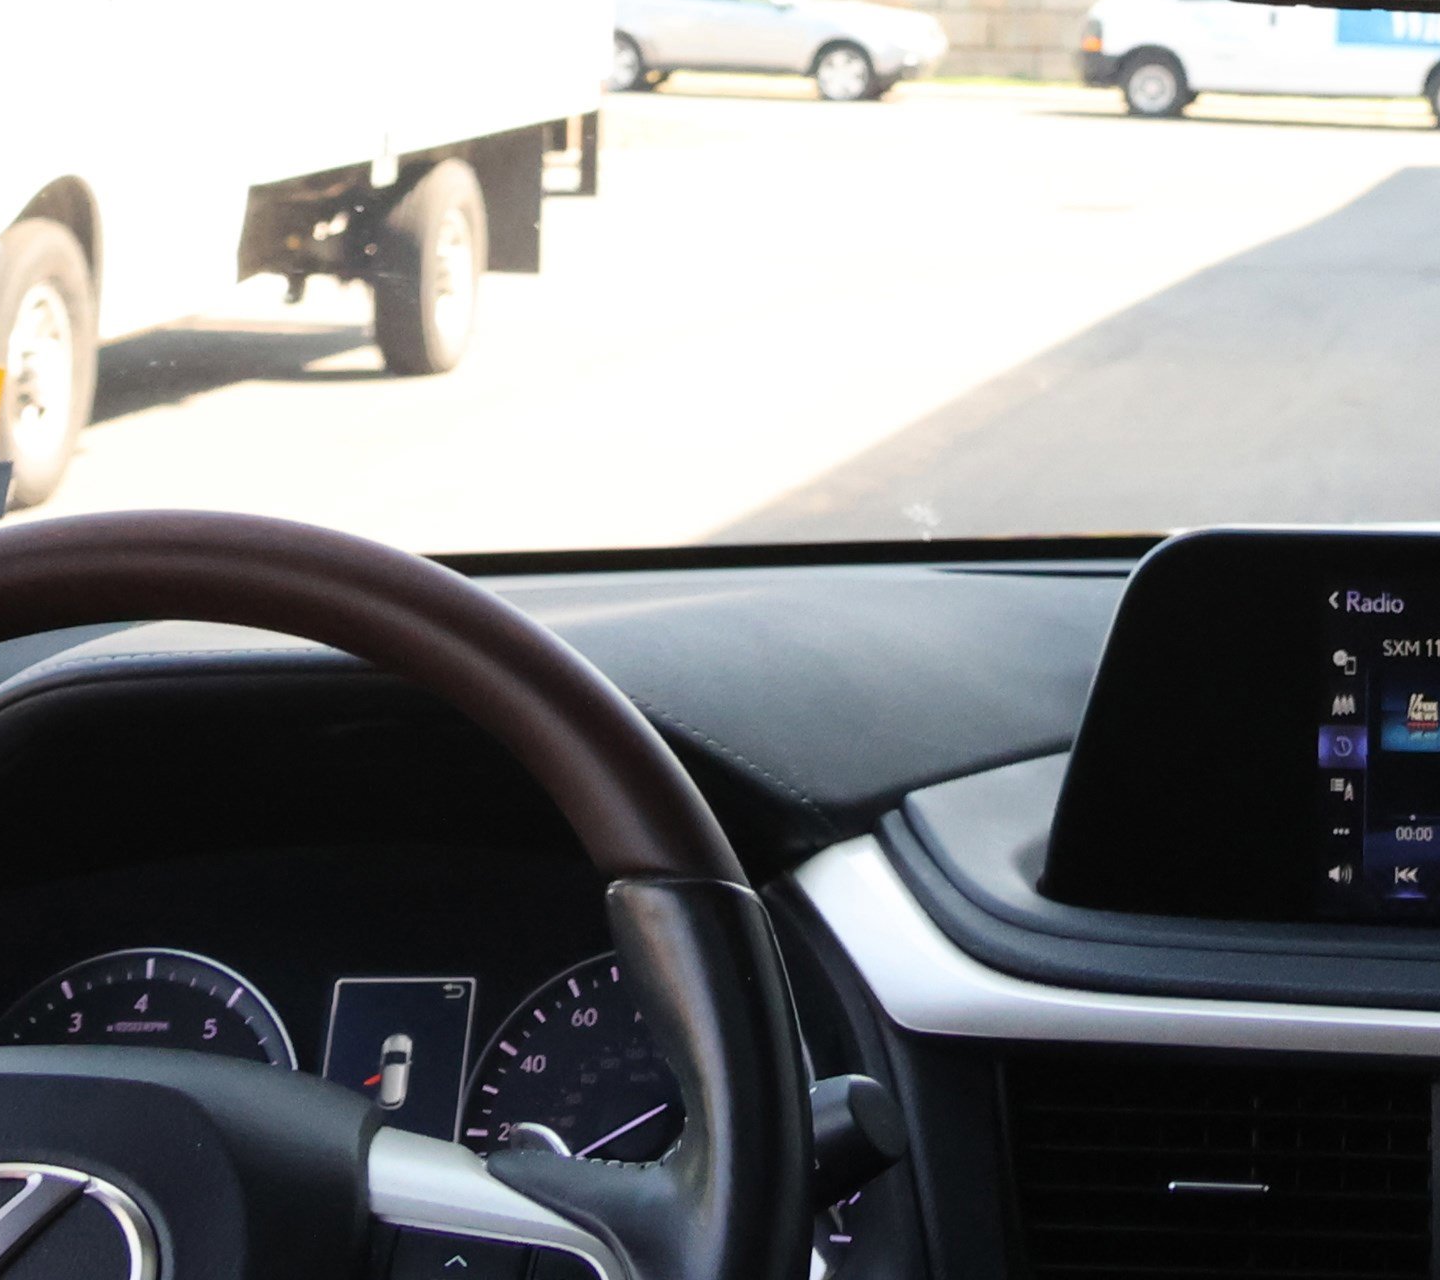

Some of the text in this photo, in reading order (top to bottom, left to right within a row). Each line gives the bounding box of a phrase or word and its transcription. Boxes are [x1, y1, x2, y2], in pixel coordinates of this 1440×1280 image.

[1346, 591, 1405, 614] Radio
[1382, 639, 1421, 657] SXM
[1395, 826, 1433, 842] 00:00
[133, 993, 150, 1014] 4
[66, 1012, 83, 1035] 3
[570, 1007, 599, 1027] 60
[201, 1017, 219, 1040] 5
[519, 1054, 547, 1074] 40
